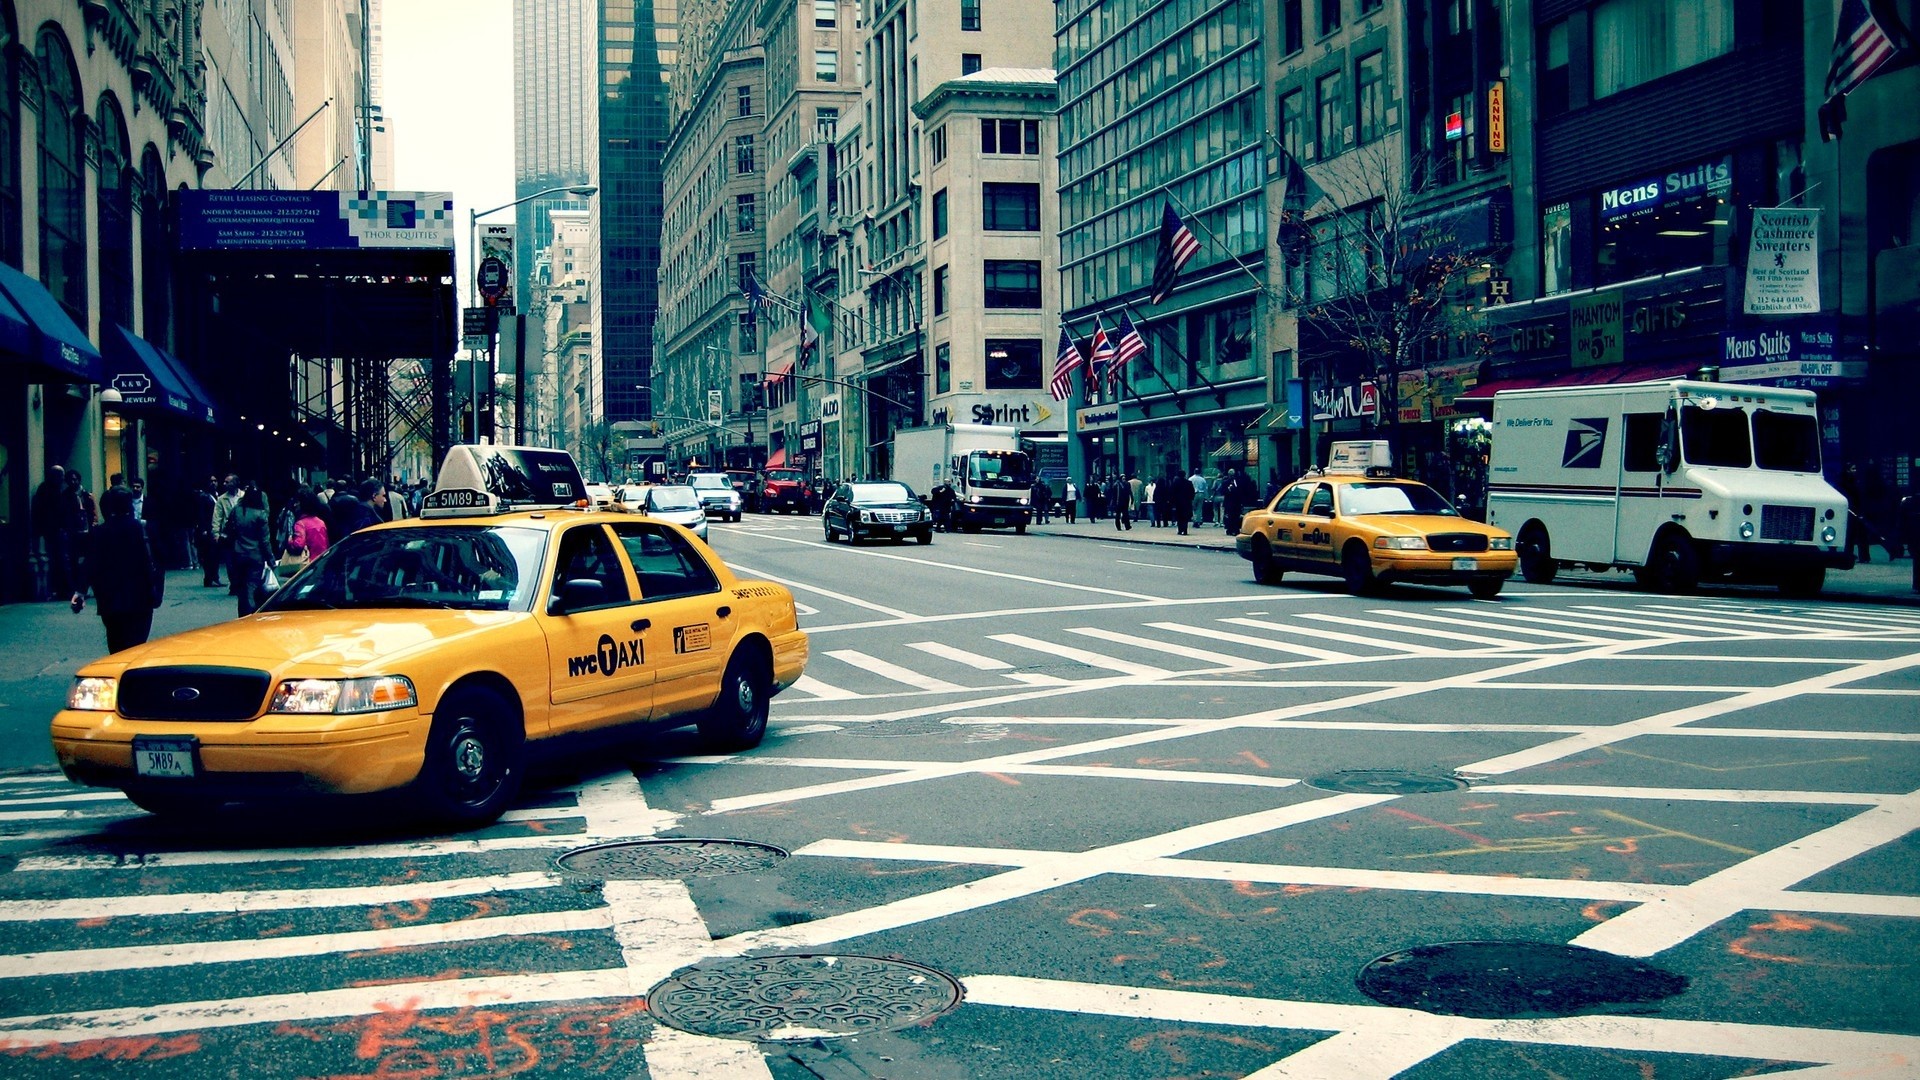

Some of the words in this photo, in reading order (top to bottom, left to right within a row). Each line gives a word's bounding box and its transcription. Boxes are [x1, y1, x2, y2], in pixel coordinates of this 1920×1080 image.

[1492, 89, 1501, 147] TANNING
[1602, 182, 1658, 211] Mens
[1665, 163, 1728, 193] Suits
[1545, 202, 1570, 215] TUXEDO
[1761, 214, 1809, 226] Scottish
[364, 231, 392, 239] THOR
[395, 231, 439, 240] EQUITIES
[1754, 227, 1815, 239] Cashmere
[1755, 239, 1810, 252] Sweaters
[1752, 268, 1767, 276] Best
[1769, 268, 1776, 276] of
[1778, 268, 1809, 276] Scotland
[1572, 301, 1621, 328] PHANTOM
[1631, 301, 1686, 335] GIFTS
[1510, 324, 1555, 353] GIFTS
[1801, 331, 1816, 344] Mens
[1817, 331, 1833, 344] Suits
[1725, 336, 1756, 361] Mens
[1758, 330, 1791, 357] Suits
[1821, 363, 1832, 375] OFF
[121, 380, 127, 388] K
[124, 396, 158, 404] JEWELRY
[823, 399, 839, 418] ALDO
[1507, 419, 1515, 427] We
[1515, 418, 1533, 427] Deliver
[1533, 418, 1543, 426] For
[441, 492, 473, 506] 5M89
[568, 655, 598, 677] NYC
[600, 638, 645, 672] TAXI
